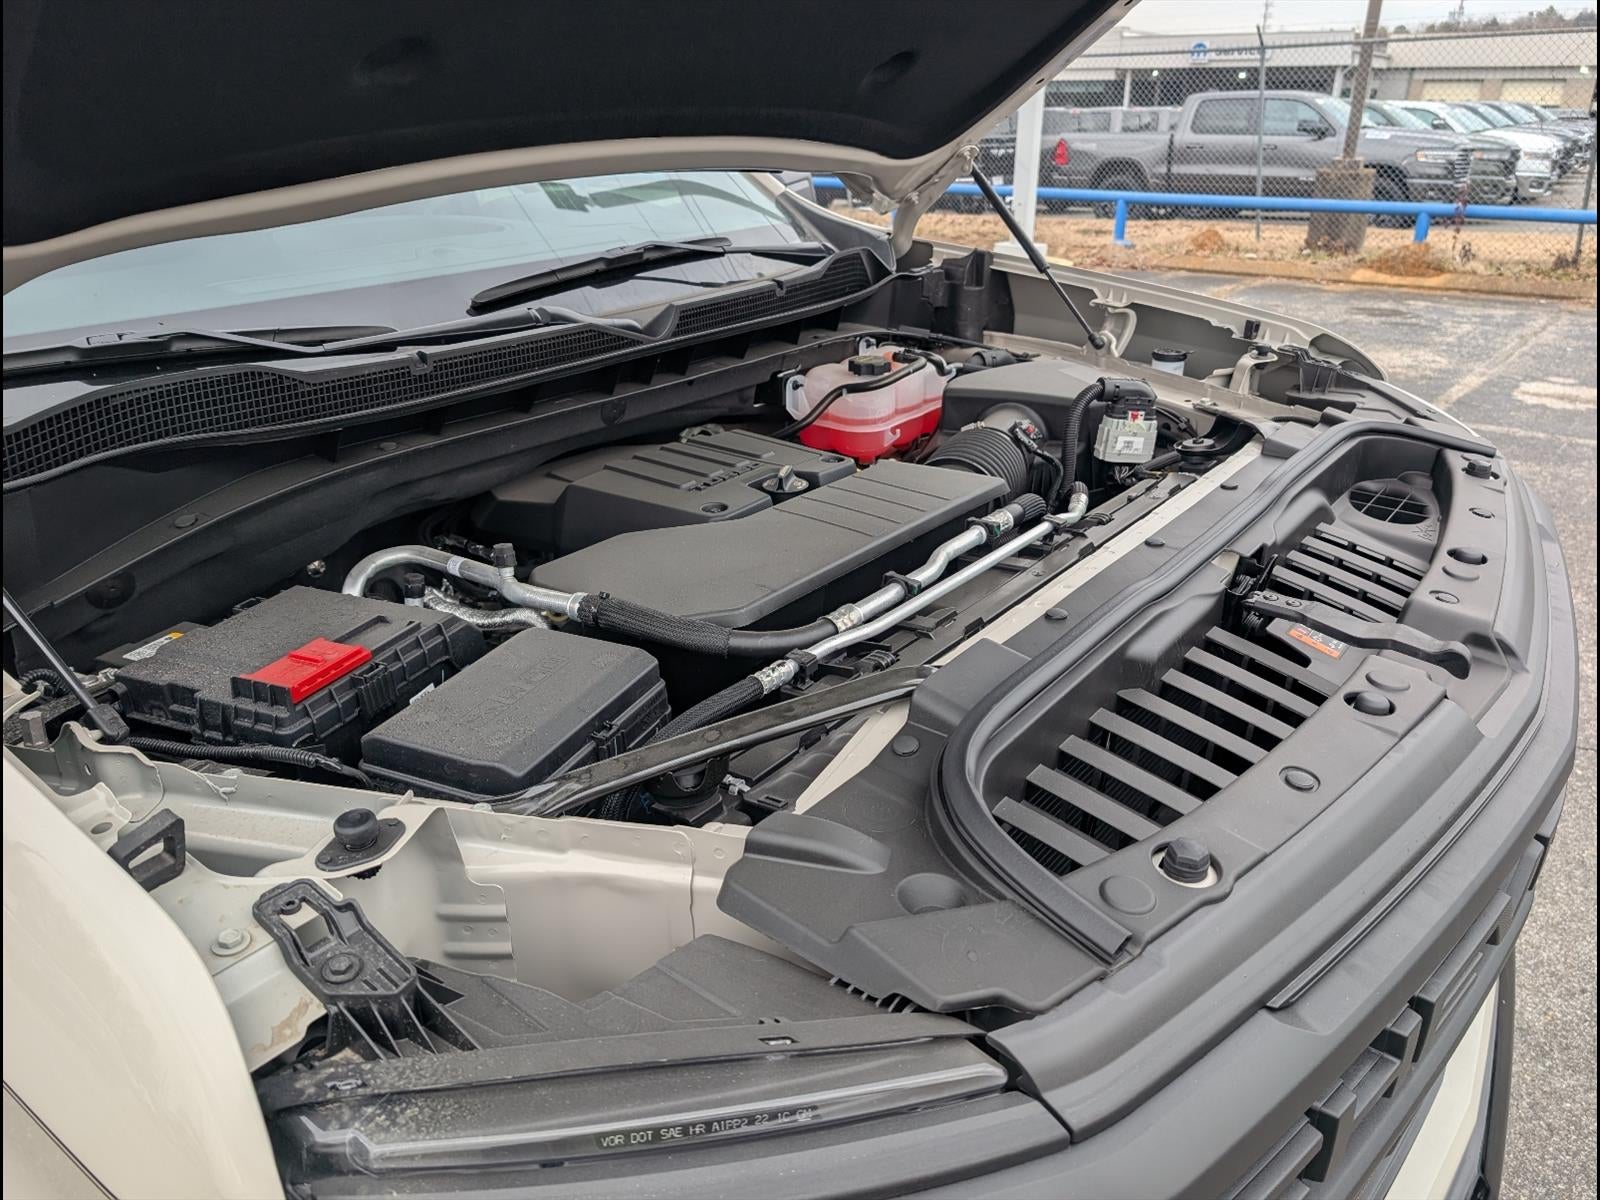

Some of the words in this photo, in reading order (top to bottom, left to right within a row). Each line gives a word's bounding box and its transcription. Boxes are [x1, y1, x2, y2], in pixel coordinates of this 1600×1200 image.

[600, 1135, 624, 1147] VOR
[630, 1131, 653, 1144] DOT
[660, 1126, 683, 1140] SAE
[754, 1113, 769, 1126] 22
